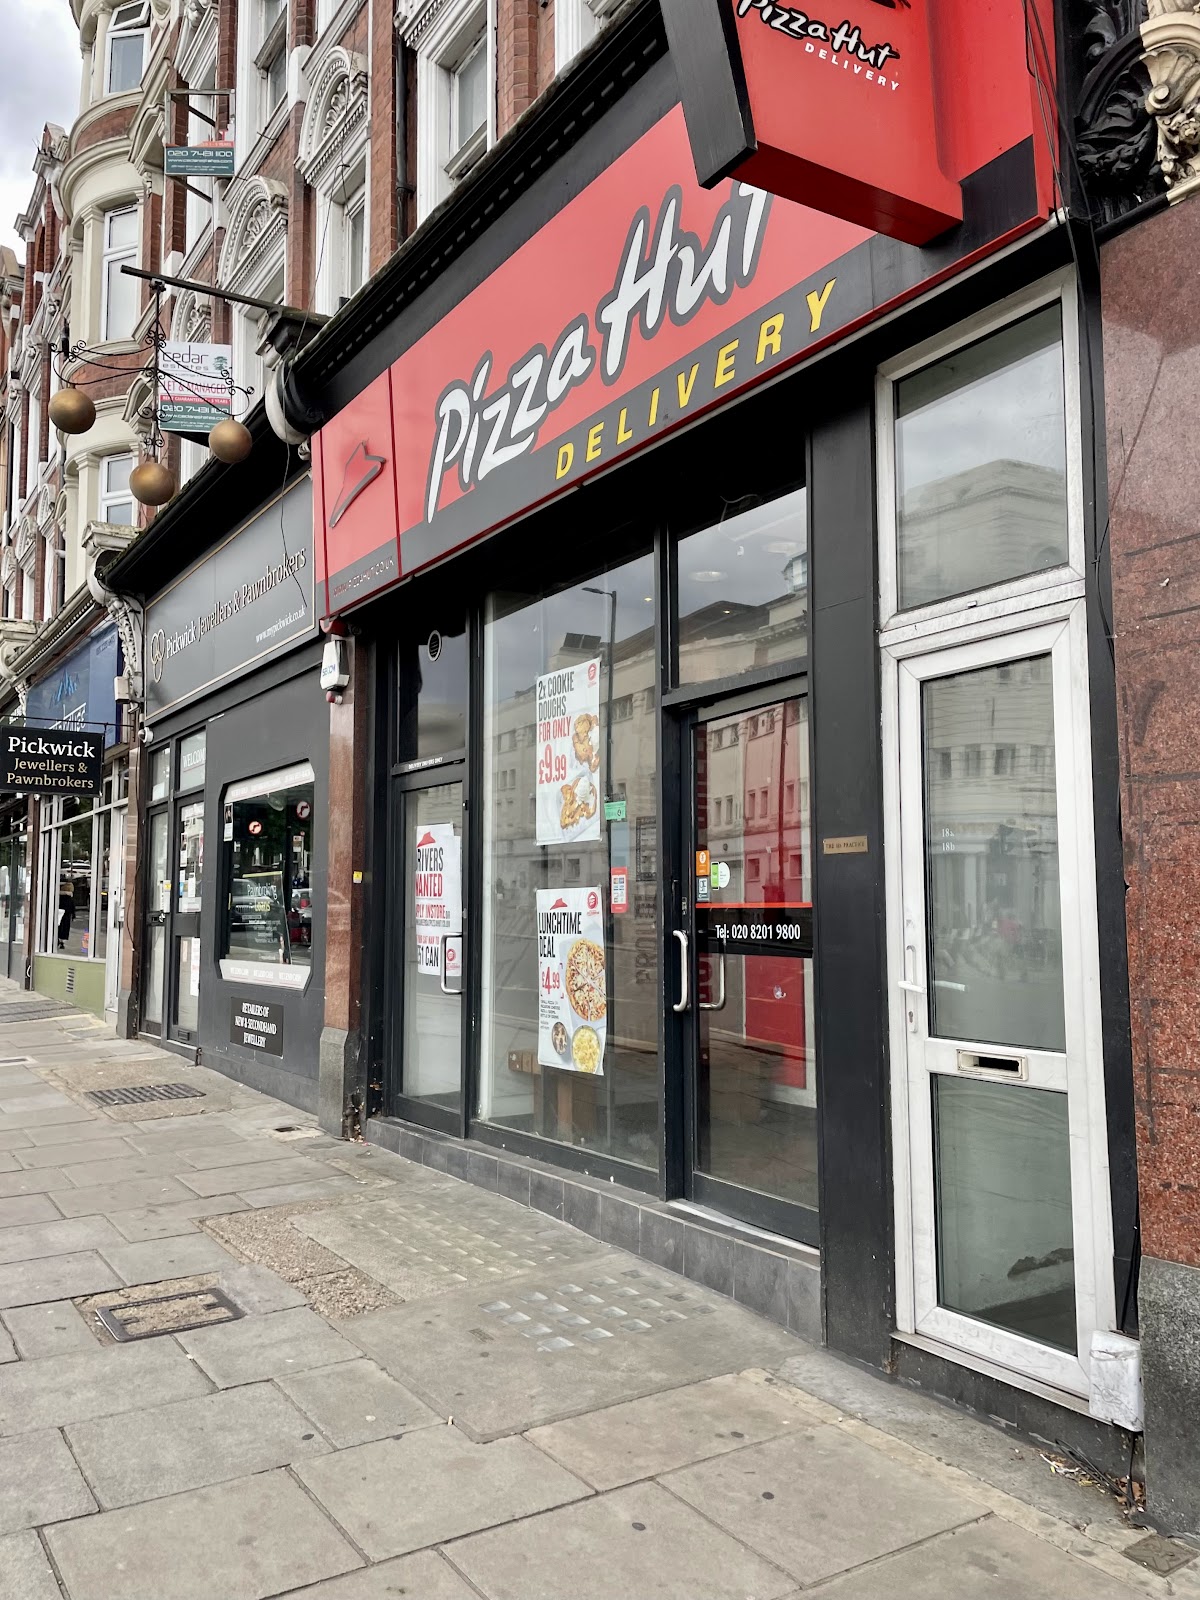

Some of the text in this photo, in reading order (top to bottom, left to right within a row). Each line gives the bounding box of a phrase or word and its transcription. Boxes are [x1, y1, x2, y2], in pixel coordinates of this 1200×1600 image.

[738, 0, 900, 70] Pizza Hut
[804, 42, 900, 91] DELIVERY
[162, 344, 209, 364] cedar
[555, 277, 837, 480] DELIVERY
[161, 404, 183, 412] 020
[425, 354, 594, 525] Pizza
[166, 620, 197, 659] Pickwick
[198, 599, 233, 642] Jewellers
[233, 590, 242, 613] &
[241, 547, 307, 608] Pawnbrokers
[538, 671, 575, 701] 2x COOKIE
[538, 694, 567, 722] DOUGHS
[538, 715, 572, 743] FOR ONLY
[7, 736, 96, 758] Pickwick
[183, 746, 206, 768] WELCOM
[14, 757, 88, 773] Jewellers &
[538, 743, 567, 785] £9.99
[6, 772, 94, 789] Pawnbrokers
[942, 827, 955, 838] 18a
[942, 841, 956, 852] 18b
[426, 903, 446, 919] INSTORE
[538, 911, 582, 935] LUNCHTIME
[715, 924, 801, 940] Tel: 020 8201 9800
[425, 945, 439, 968] CAN
[539, 935, 556, 958] DEAL
[541, 966, 560, 995] £4.99
[242, 1002, 270, 1017] RETAILERS OF
[234, 1015, 244, 1027] NEW
[247, 1018, 277, 1035] SECONDHAND
[243, 1031, 267, 1048] JEWELLERY
